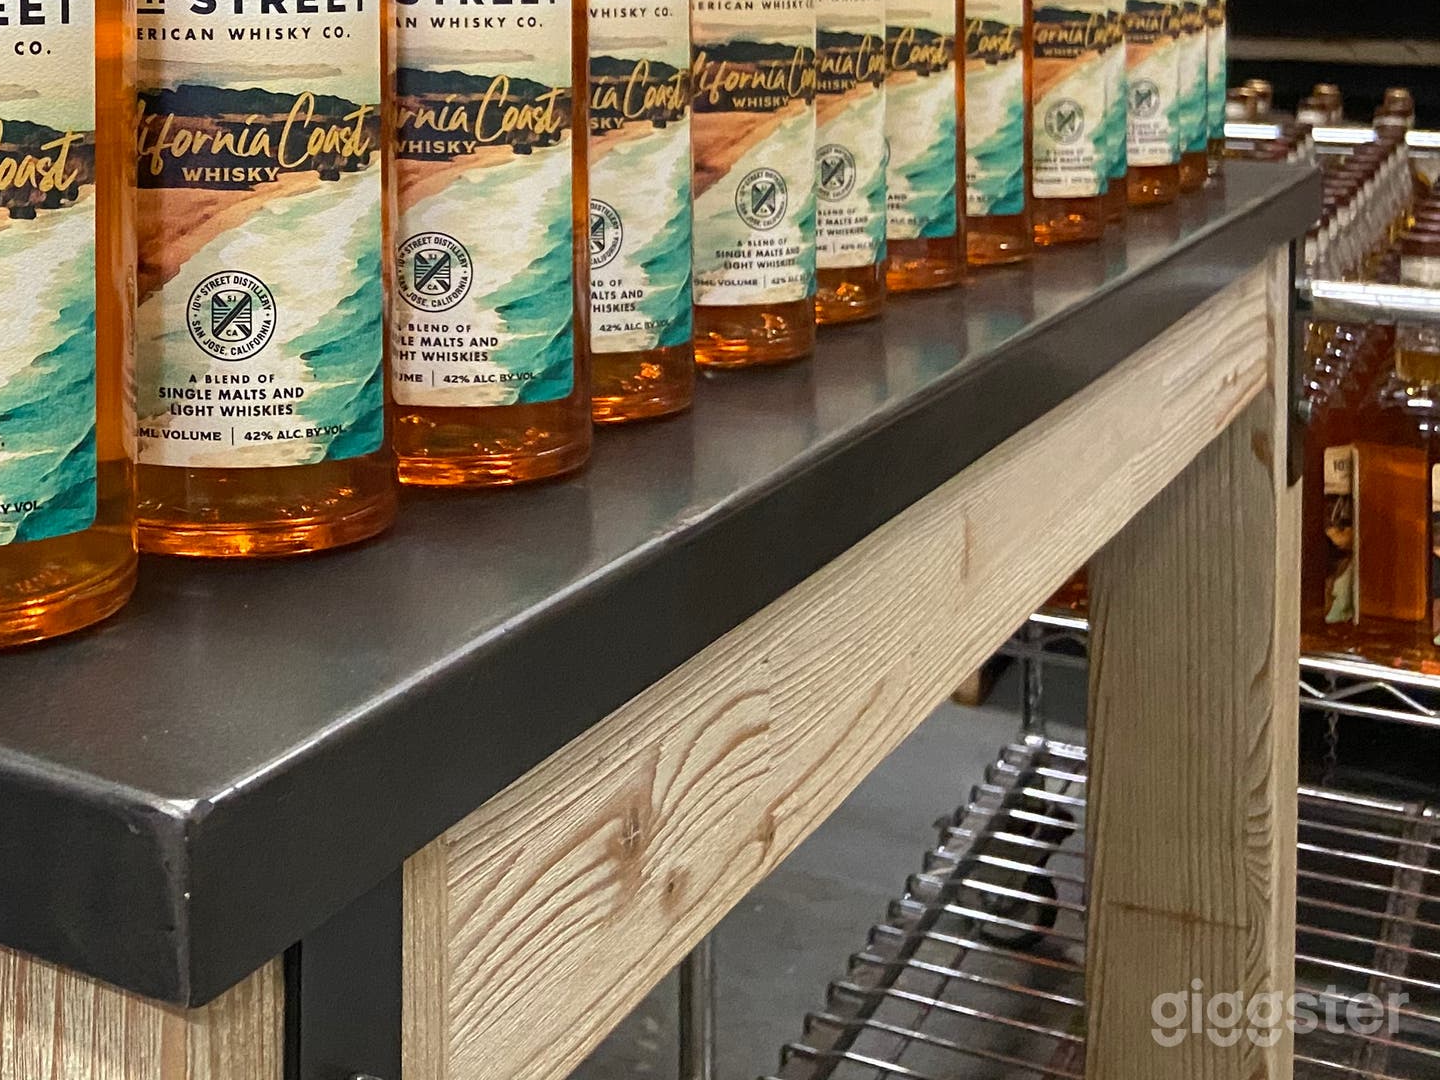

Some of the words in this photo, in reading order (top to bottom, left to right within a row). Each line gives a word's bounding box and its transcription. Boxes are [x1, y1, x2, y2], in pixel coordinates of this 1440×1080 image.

[698, 2, 753, 10] ERICAN
[762, 0, 803, 9] WHISKY
[655, 8, 672, 16] CO.
[430, 17, 506, 28] WHISKY
[517, 16, 543, 28] CO.
[137, 27, 214, 41] ERICAN
[228, 28, 311, 41] WHISKY
[322, 26, 350, 39] CO.
[14, 40, 51, 56] CO.
[893, 27, 947, 69] Coast
[623, 58, 684, 118] Coast
[474, 74, 564, 142] Coast
[732, 97, 788, 108] WHISKY
[278, 91, 373, 168] Coast
[182, 167, 280, 182] WHISKY
[404, 236, 432, 254] STREET
[434, 236, 468, 269] DISTILLERY
[756, 250, 783, 258] MALTS
[610, 279, 623, 287] OF
[201, 276, 231, 297] STREET
[233, 276, 272, 311] DISTILLERY
[431, 276, 468, 308] CALIFORNIA
[591, 291, 616, 299] ALTS
[621, 290, 643, 298] AND
[593, 304, 636, 313] HISKIES
[226, 329, 238, 337] CA
[409, 324, 449, 332] BLEND
[599, 324, 622, 332] 42%
[192, 321, 205, 343] SAN
[230, 319, 272, 356] CALIFORNIA
[420, 337, 464, 347] MALTS
[470, 337, 498, 347] AND
[422, 351, 488, 361] WHISKIES
[189, 374, 197, 383] A
[205, 374, 250, 384] BLEND
[258, 374, 275, 384] OF
[443, 375, 470, 383] 42%
[500, 373, 514, 381] BY
[159, 387, 212, 400] SINGLE
[219, 388, 266, 400] MALTS
[273, 387, 304, 399] AND
[170, 403, 214, 417] LIGHT
[221, 403, 293, 417] WHISKIES
[162, 429, 222, 441] VOLUME
[244, 430, 272, 441] 42%
[306, 427, 325, 438] BY
